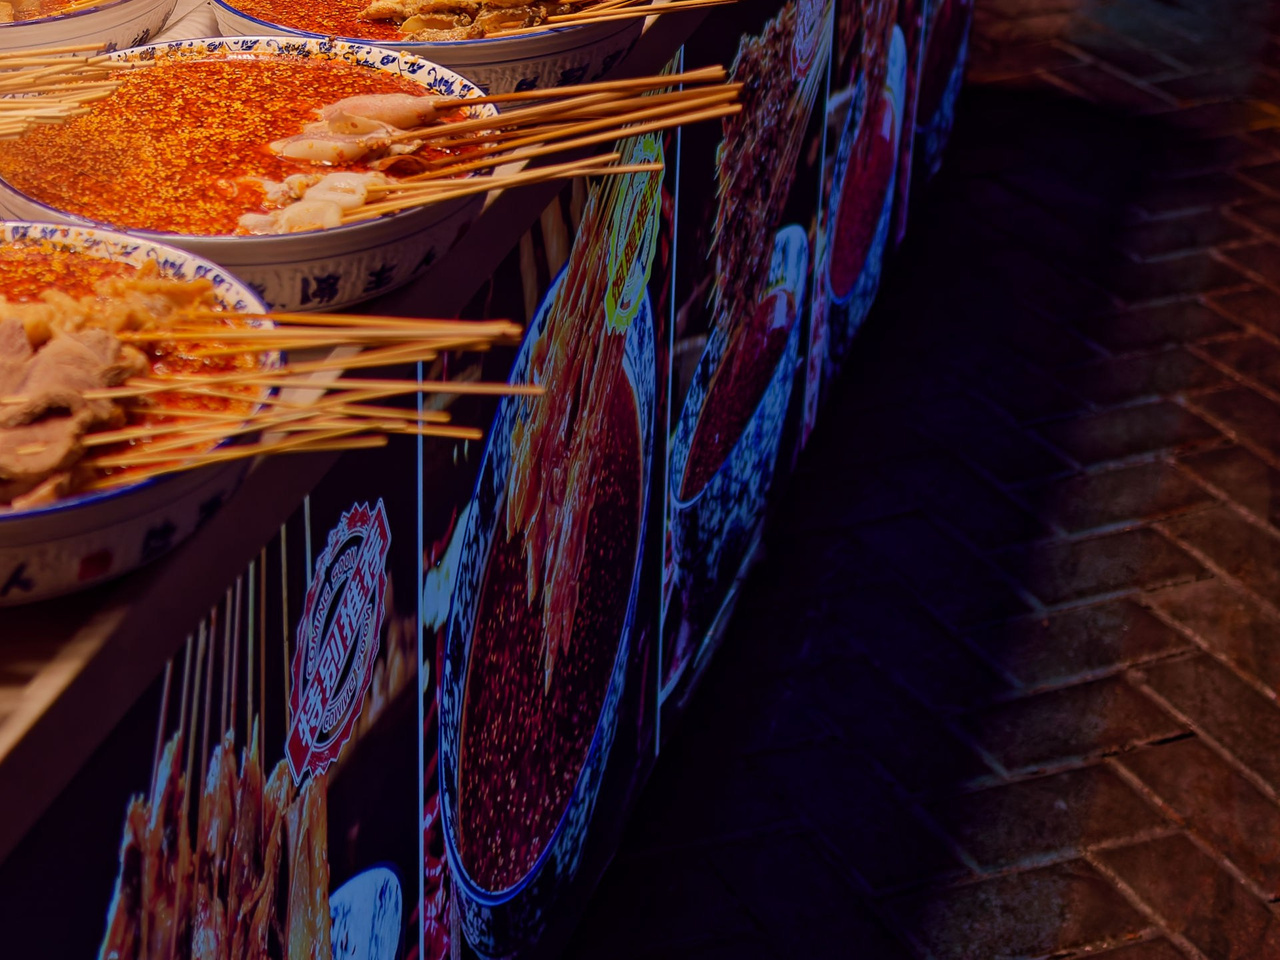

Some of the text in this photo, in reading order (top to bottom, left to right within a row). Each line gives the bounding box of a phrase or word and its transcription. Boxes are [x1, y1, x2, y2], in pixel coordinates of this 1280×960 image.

[299, 520, 383, 748] 特别推荐
[307, 544, 358, 679] COMING SOON
